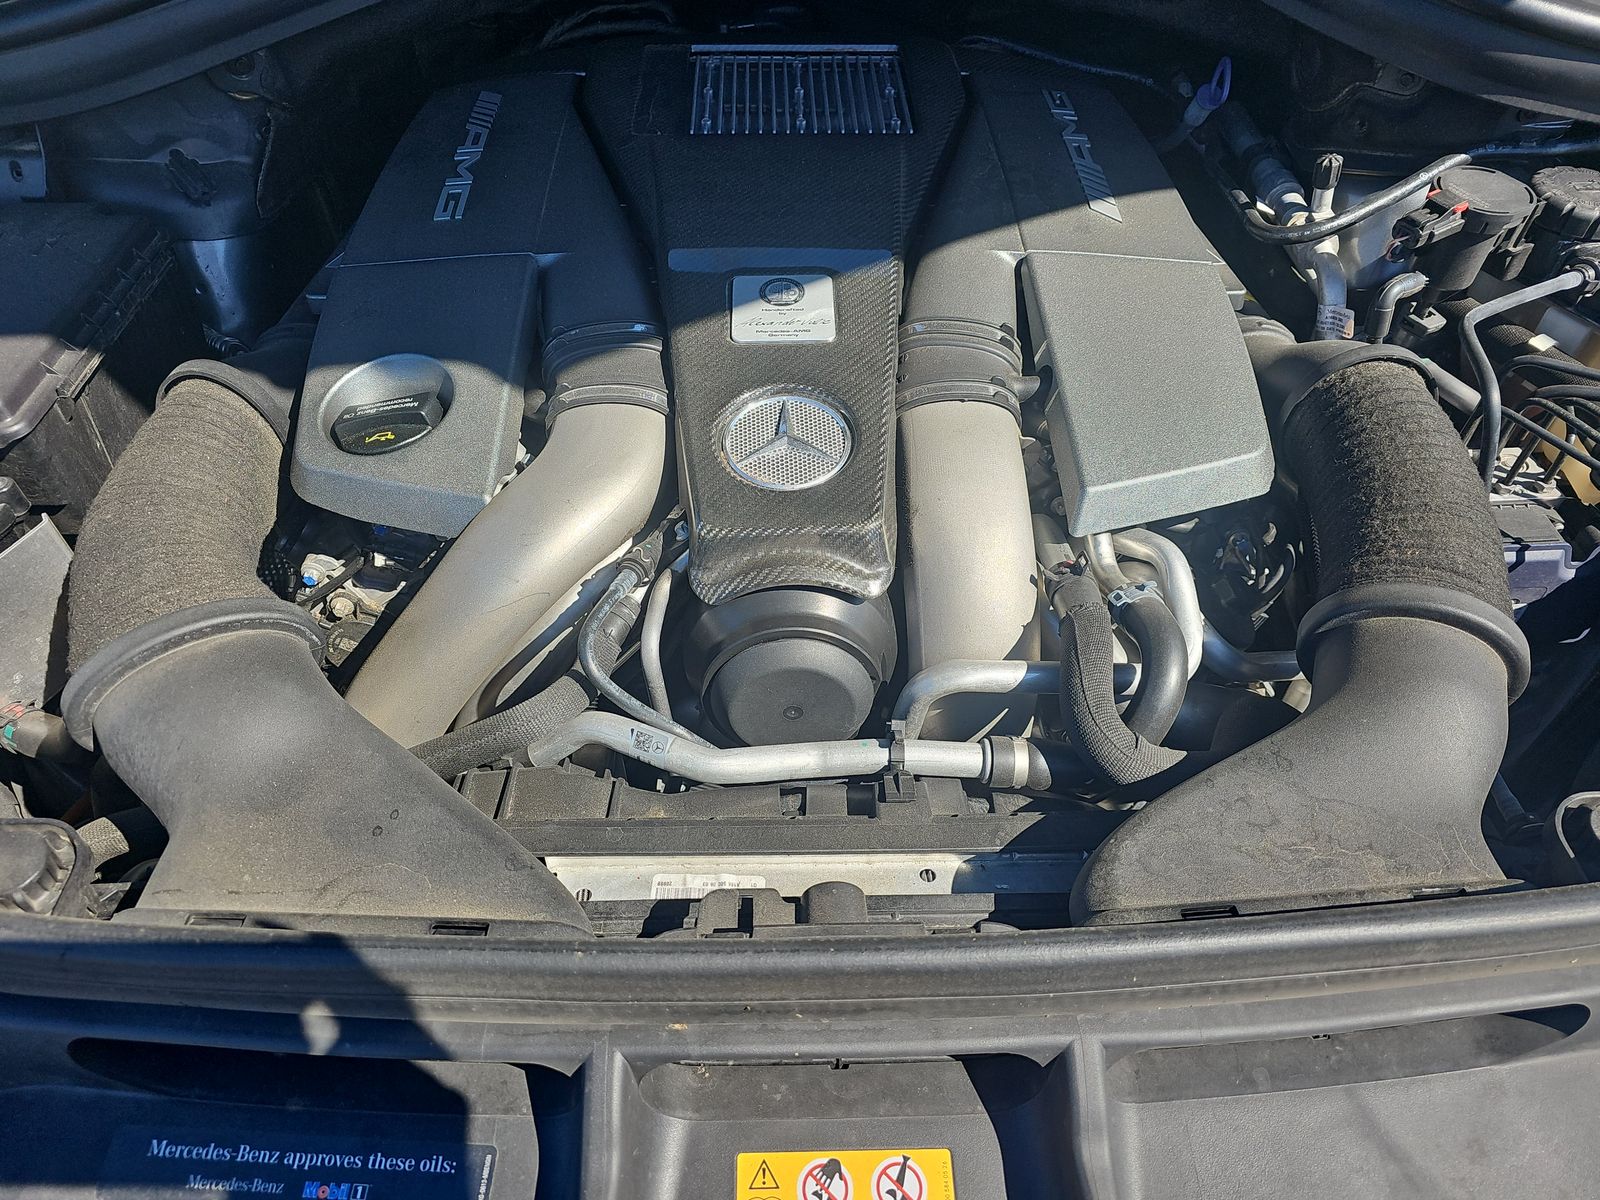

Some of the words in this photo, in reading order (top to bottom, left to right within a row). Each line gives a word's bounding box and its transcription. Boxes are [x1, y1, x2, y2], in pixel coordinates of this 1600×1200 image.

[356, 397, 414, 412] recommended
[356, 401, 419, 416] Mercedes-Benz
[147, 1139, 280, 1164] Mercedes-Benz
[284, 1151, 362, 1170] approves
[368, 1152, 415, 1171] these
[419, 1155, 457, 1174] oils:
[186, 1174, 285, 1194] Mercedes-Benz
[302, 1181, 350, 1200] Mobil
